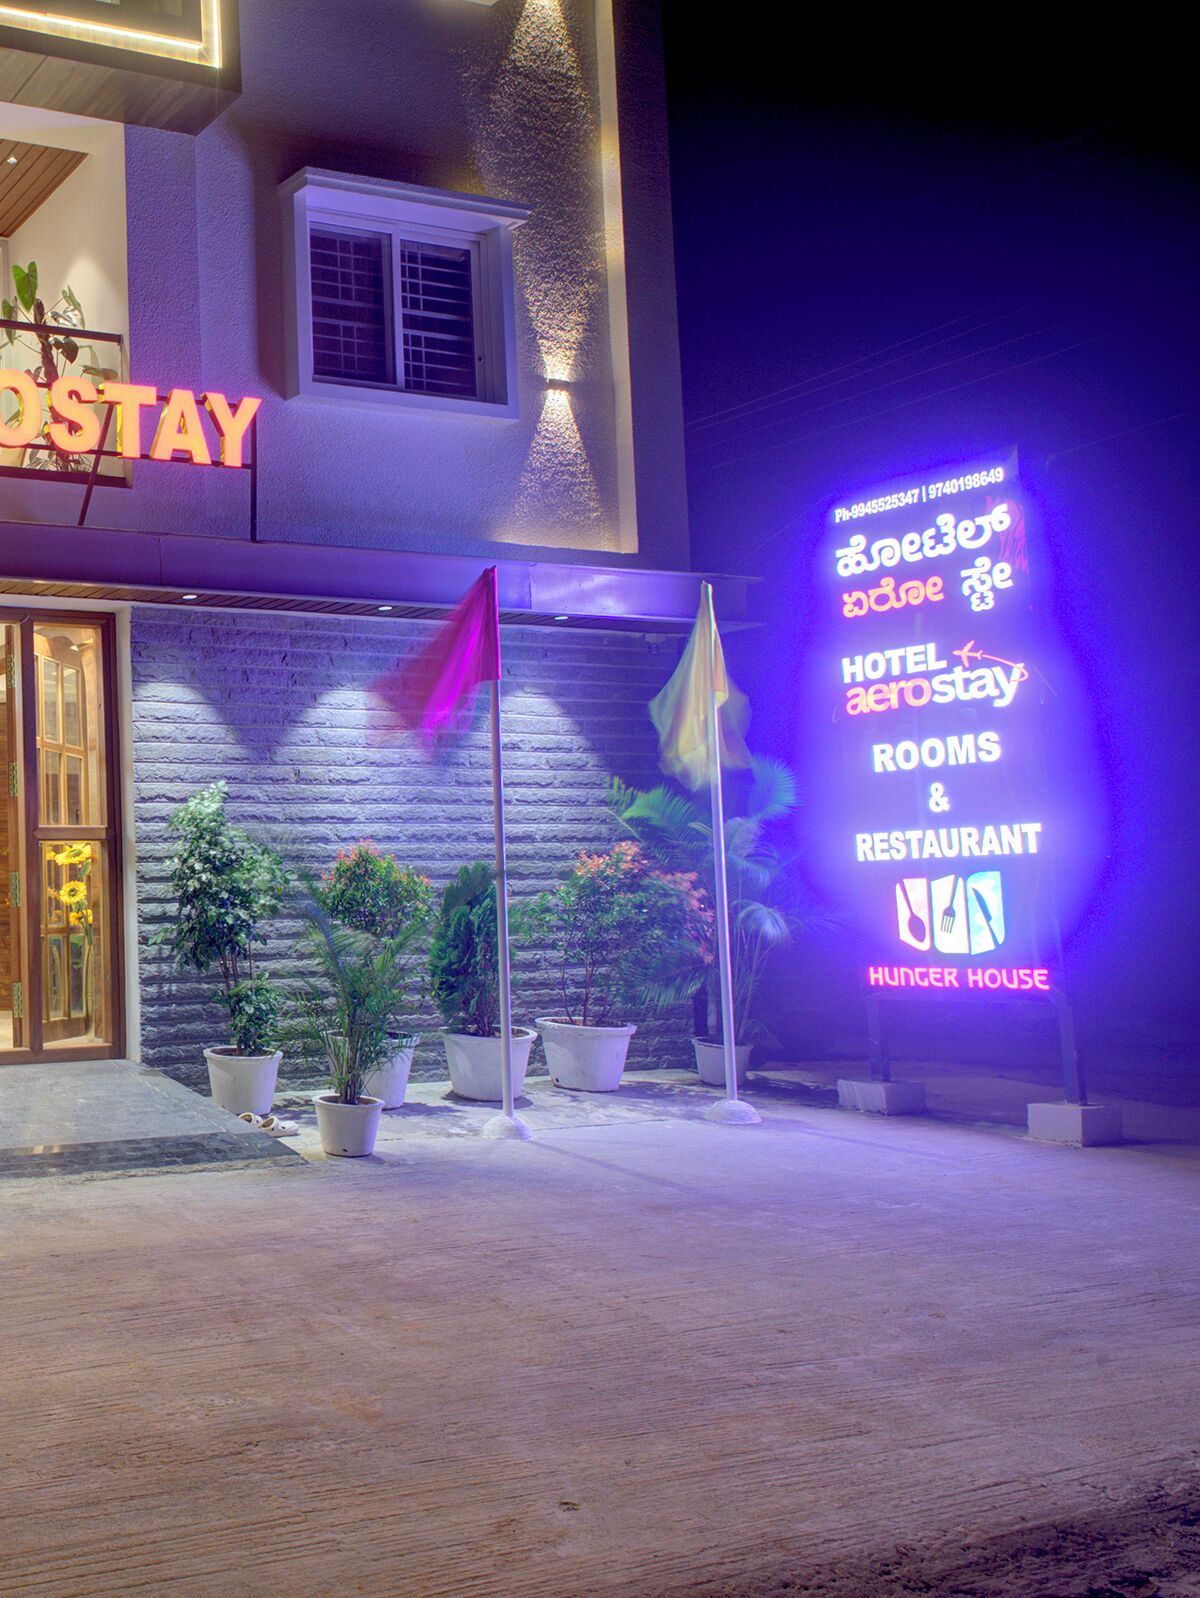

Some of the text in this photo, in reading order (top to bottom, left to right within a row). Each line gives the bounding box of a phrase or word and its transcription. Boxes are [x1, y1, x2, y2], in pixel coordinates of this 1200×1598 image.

[928, 467, 1005, 499] 9740198649
[841, 642, 947, 683] HOTEL
[846, 662, 1025, 716] aerostay
[872, 731, 1001, 772] ROOMS
[929, 782, 950, 813] &
[855, 822, 1042, 862] RESTAURANT
[868, 966, 1050, 990] HUNGER HOUSE
